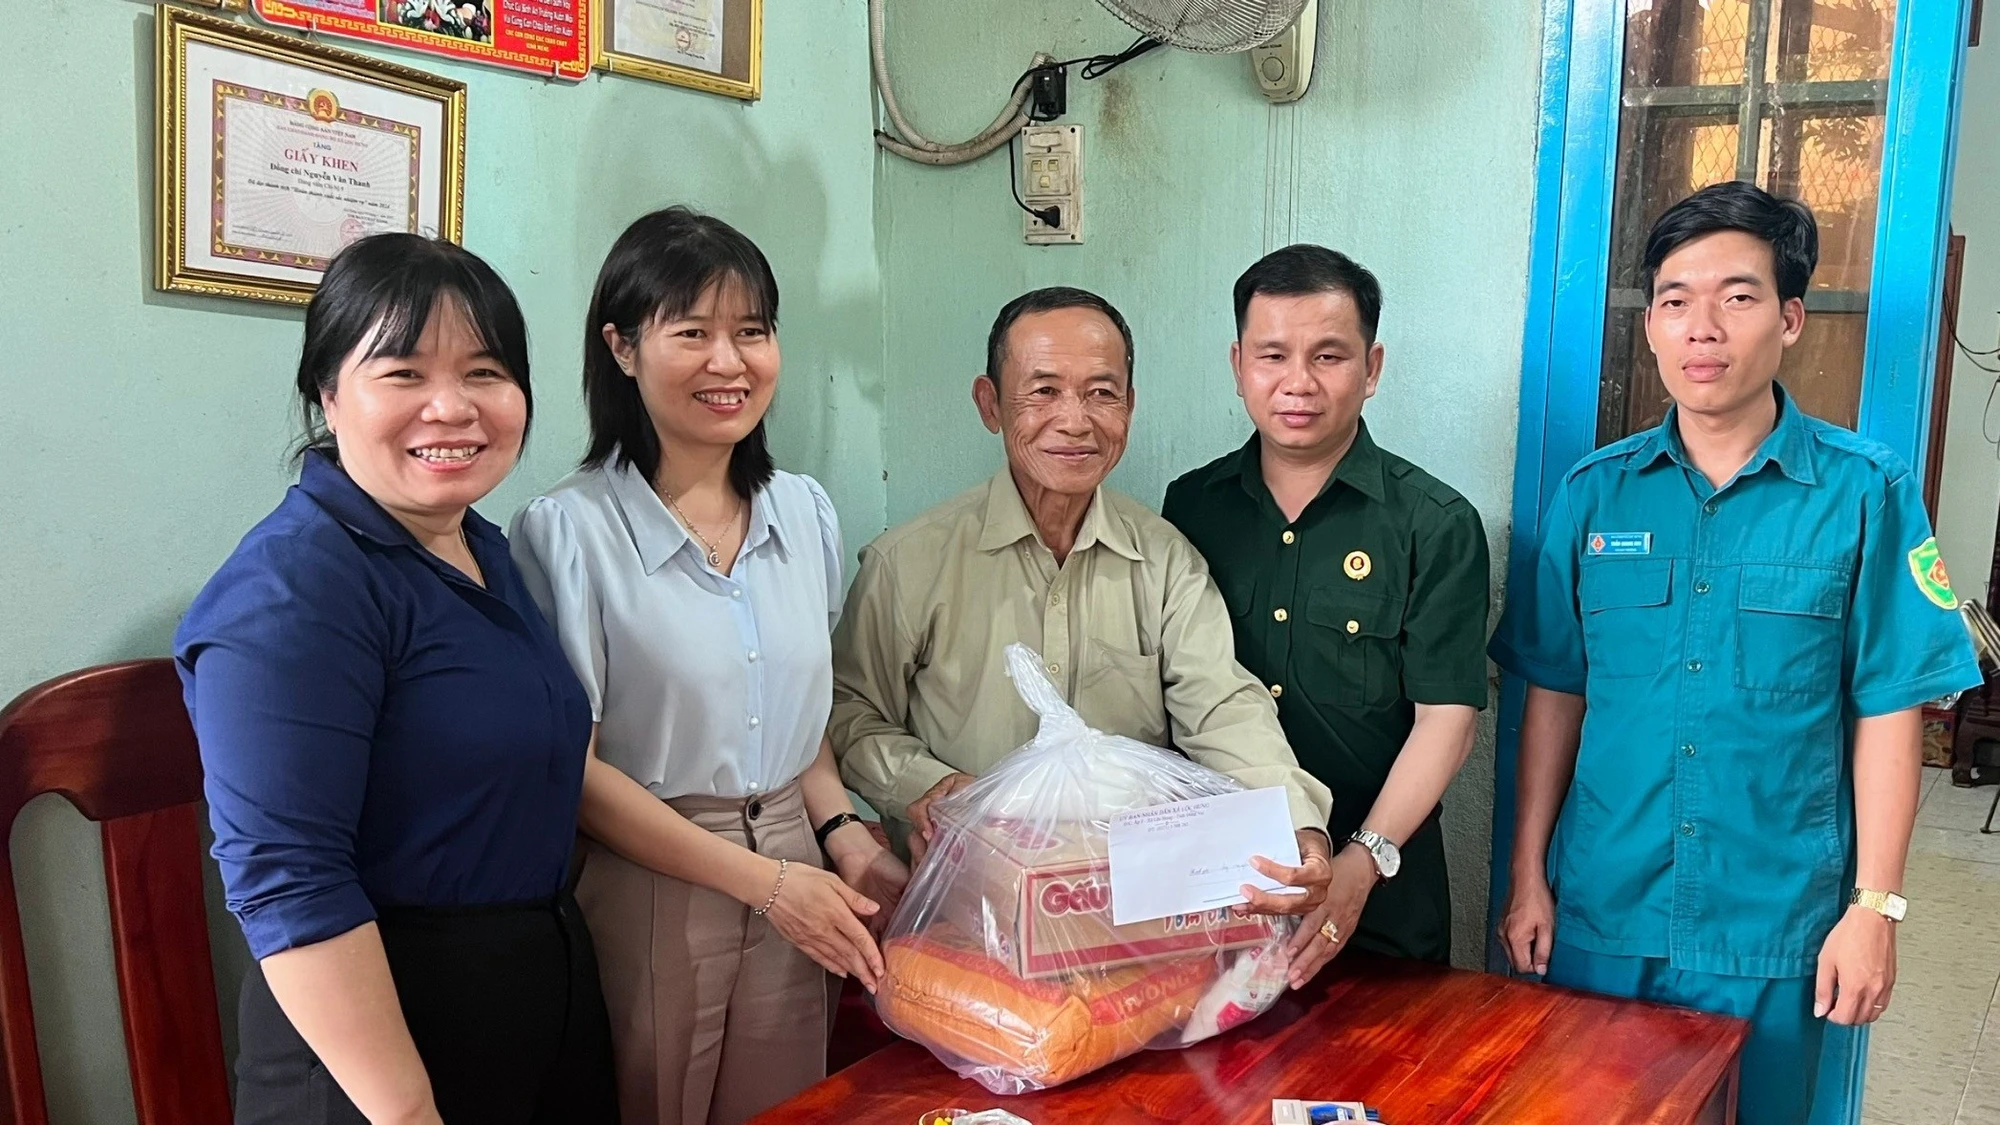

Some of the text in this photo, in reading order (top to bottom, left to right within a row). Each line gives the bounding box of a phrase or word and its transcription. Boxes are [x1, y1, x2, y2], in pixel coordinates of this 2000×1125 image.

[284, 148, 359, 172] GIẤY KHEN
[270, 161, 370, 188] Đồng chí Nguyễn Văn Thanh
[1039, 876, 1110, 918] Gấu
